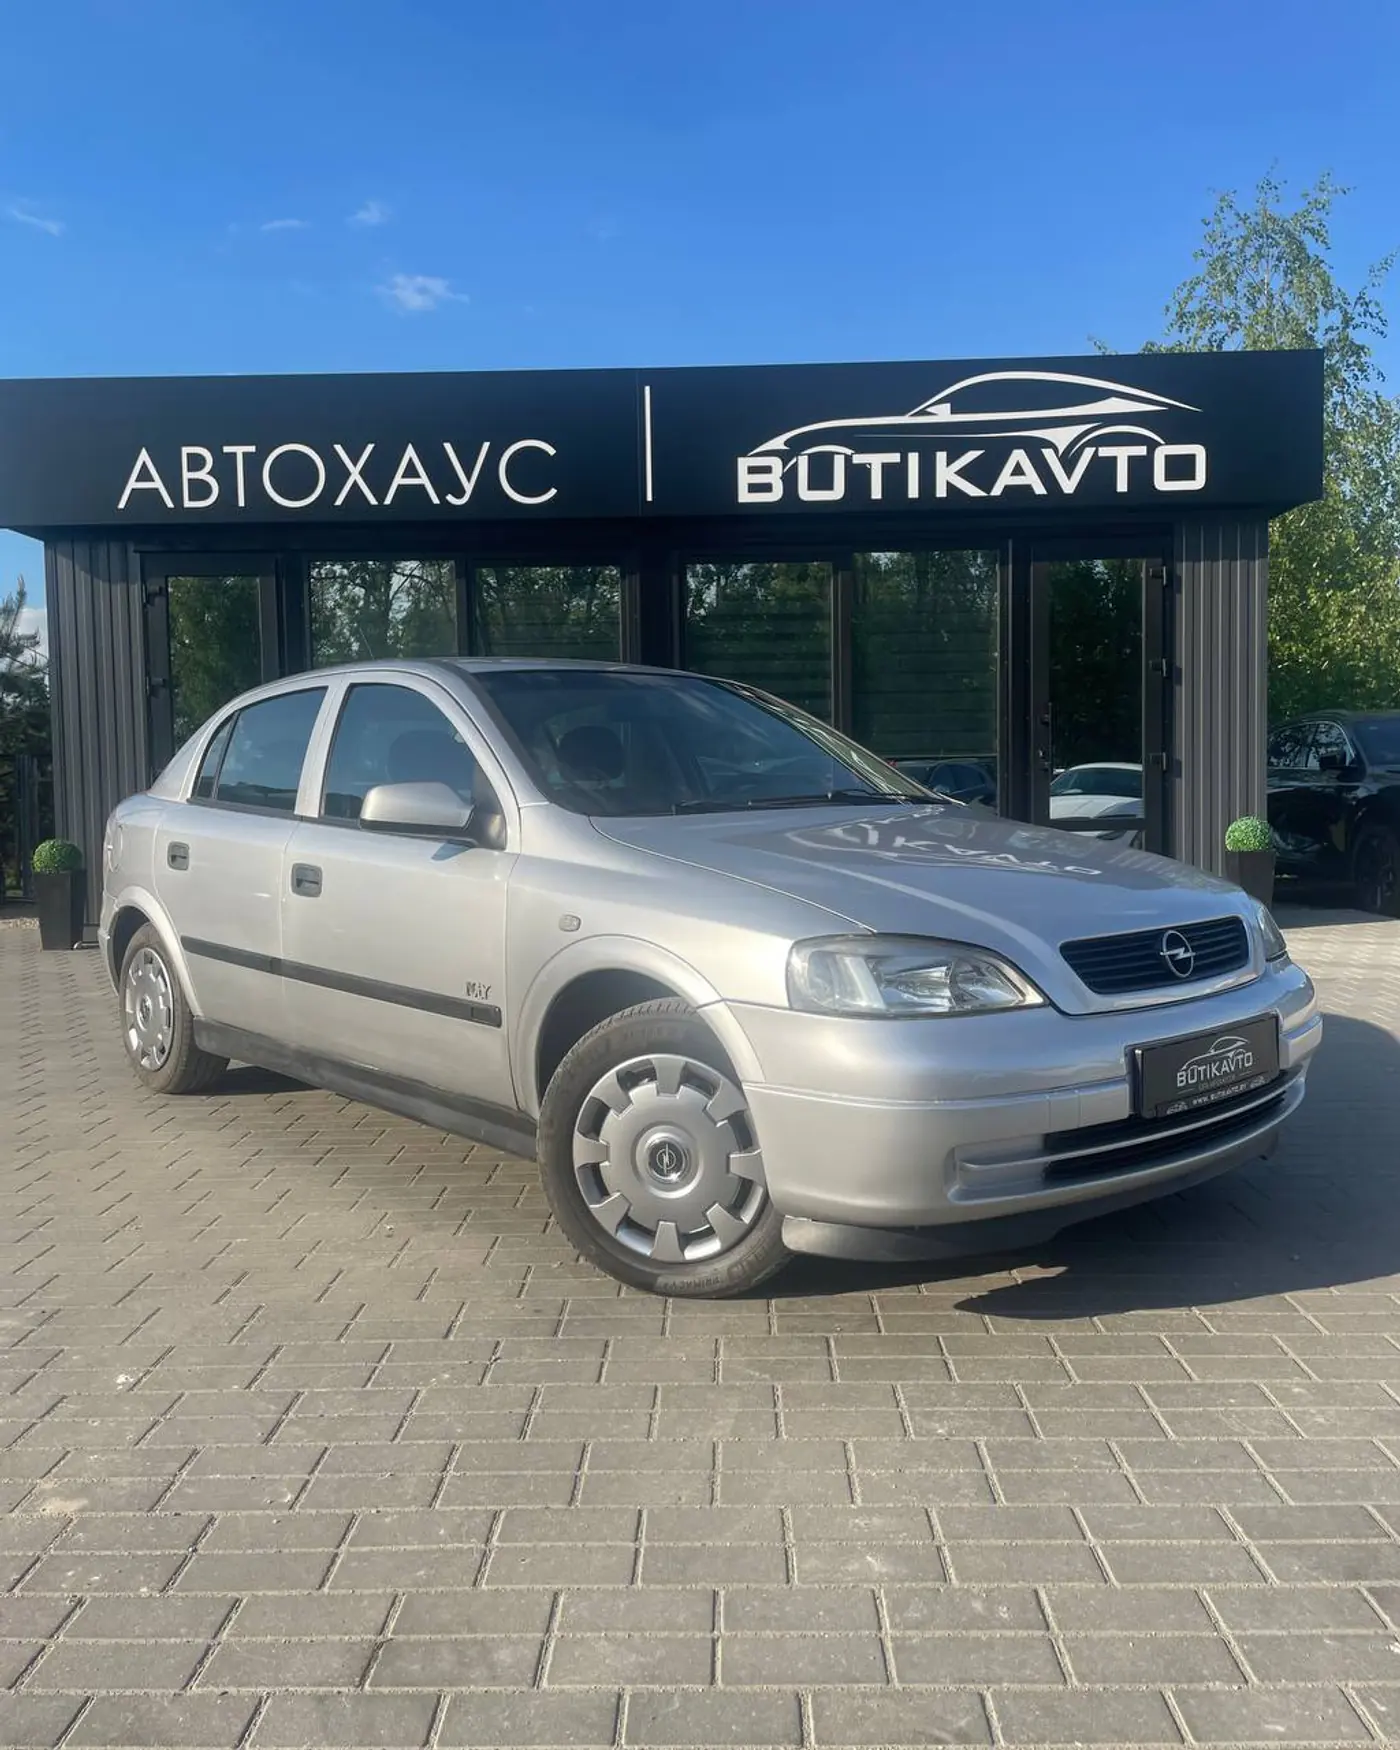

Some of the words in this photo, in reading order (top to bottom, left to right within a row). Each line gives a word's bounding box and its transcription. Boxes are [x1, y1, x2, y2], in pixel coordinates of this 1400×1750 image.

[118, 440, 557, 508] АВТОХАУС
[737, 443, 1207, 504] BUTIKAVTO
[1177, 1052, 1253, 1087] BUTIKAVTO
